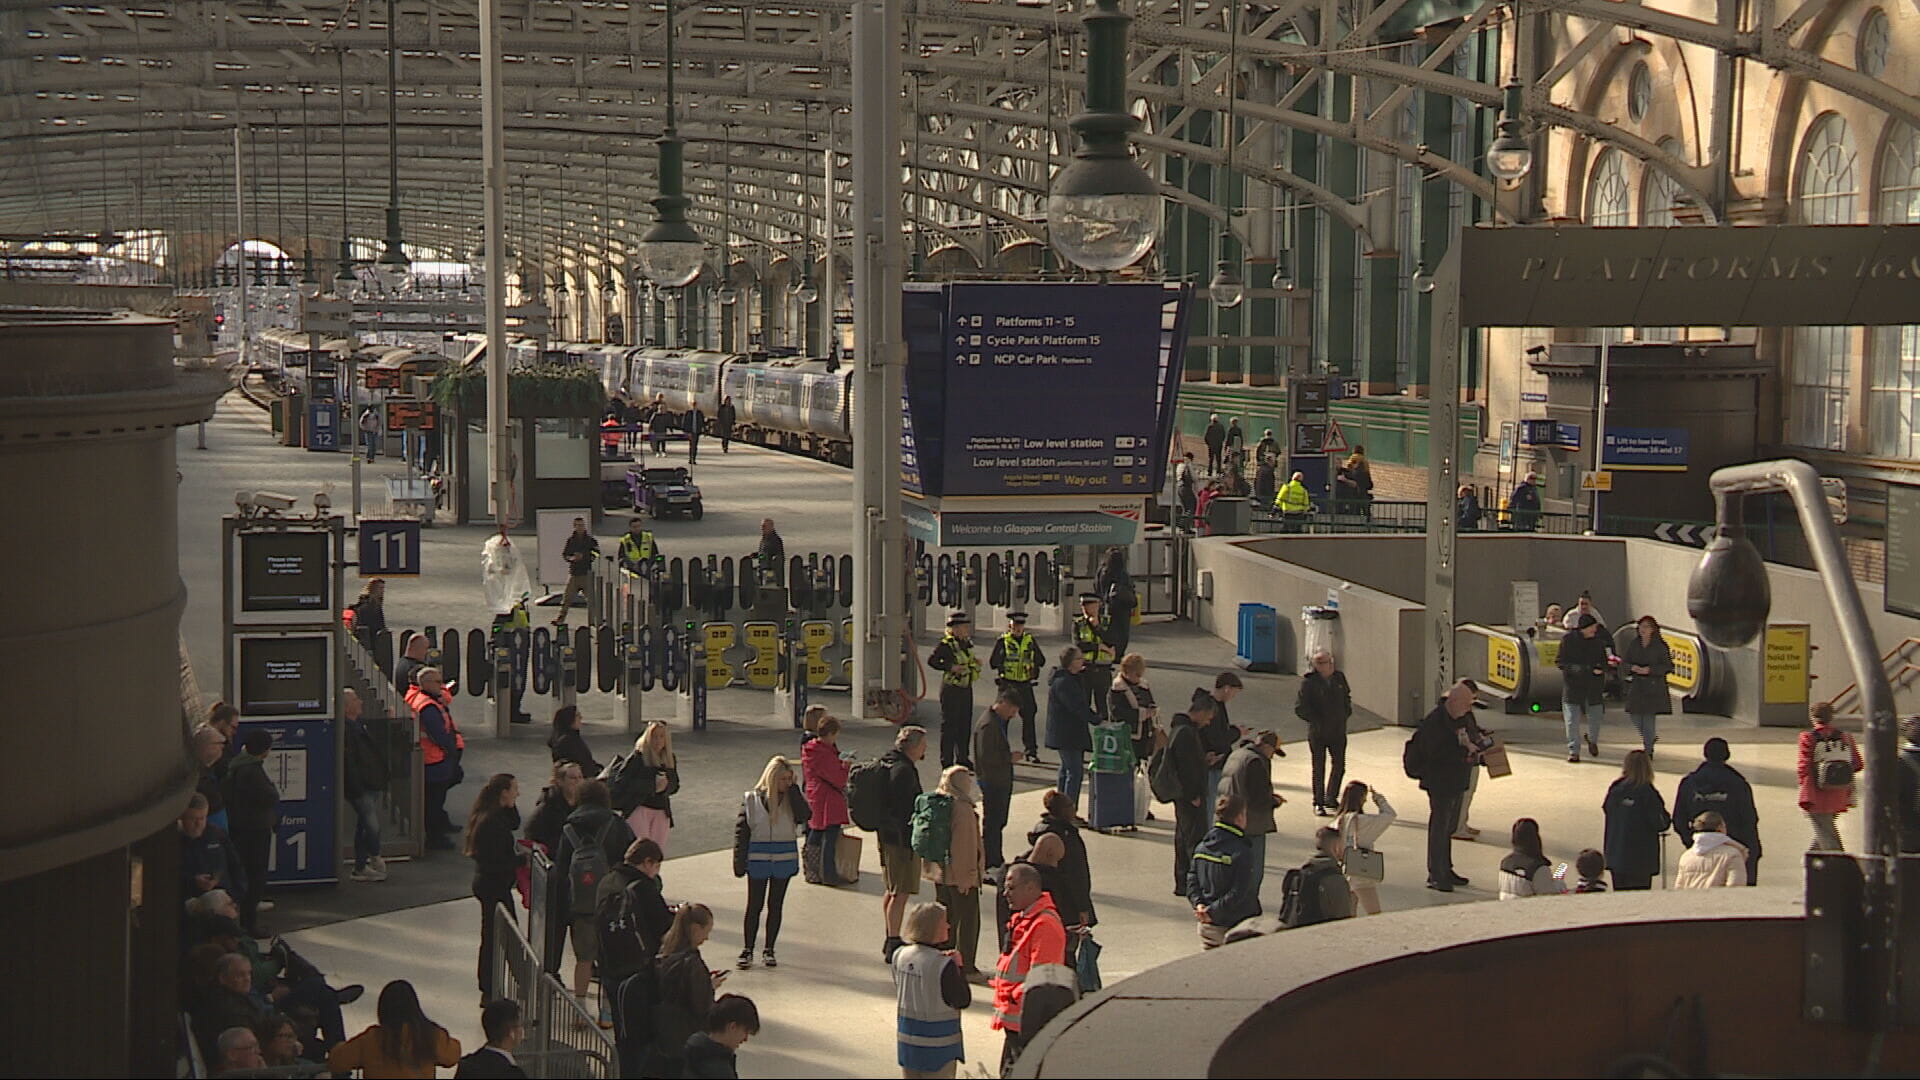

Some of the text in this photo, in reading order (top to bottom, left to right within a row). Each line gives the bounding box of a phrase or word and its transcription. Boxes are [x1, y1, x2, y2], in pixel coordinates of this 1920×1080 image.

[1520, 255, 1834, 281] PLATFORMS
[995, 316, 1042, 327] Platforms
[1045, 316, 1054, 327] 11
[1064, 316, 1075, 327] 15
[986, 335, 1100, 347] Cycle Park Platform 15
[994, 354, 1015, 365] NCP
[1017, 354, 1034, 365] Car
[1037, 354, 1058, 365] Park
[1343, 382, 1359, 397] 15
[316, 434, 332, 445] 12
[1023, 438, 1104, 448] Low level station
[1616, 437, 1628, 445] Lift
[1651, 437, 1668, 445] level
[973, 457, 994, 467] Low
[996, 457, 1019, 467] level
[1021, 457, 1056, 467] station
[1064, 474, 1107, 486] Way out
[951, 522, 1112, 536] Welcome to Glasgow Central Station
[372, 531, 407, 569] 11
[1767, 643, 1793, 651] Please
[1767, 653, 1800, 661] hold the
[1102, 734, 1119, 754] D
